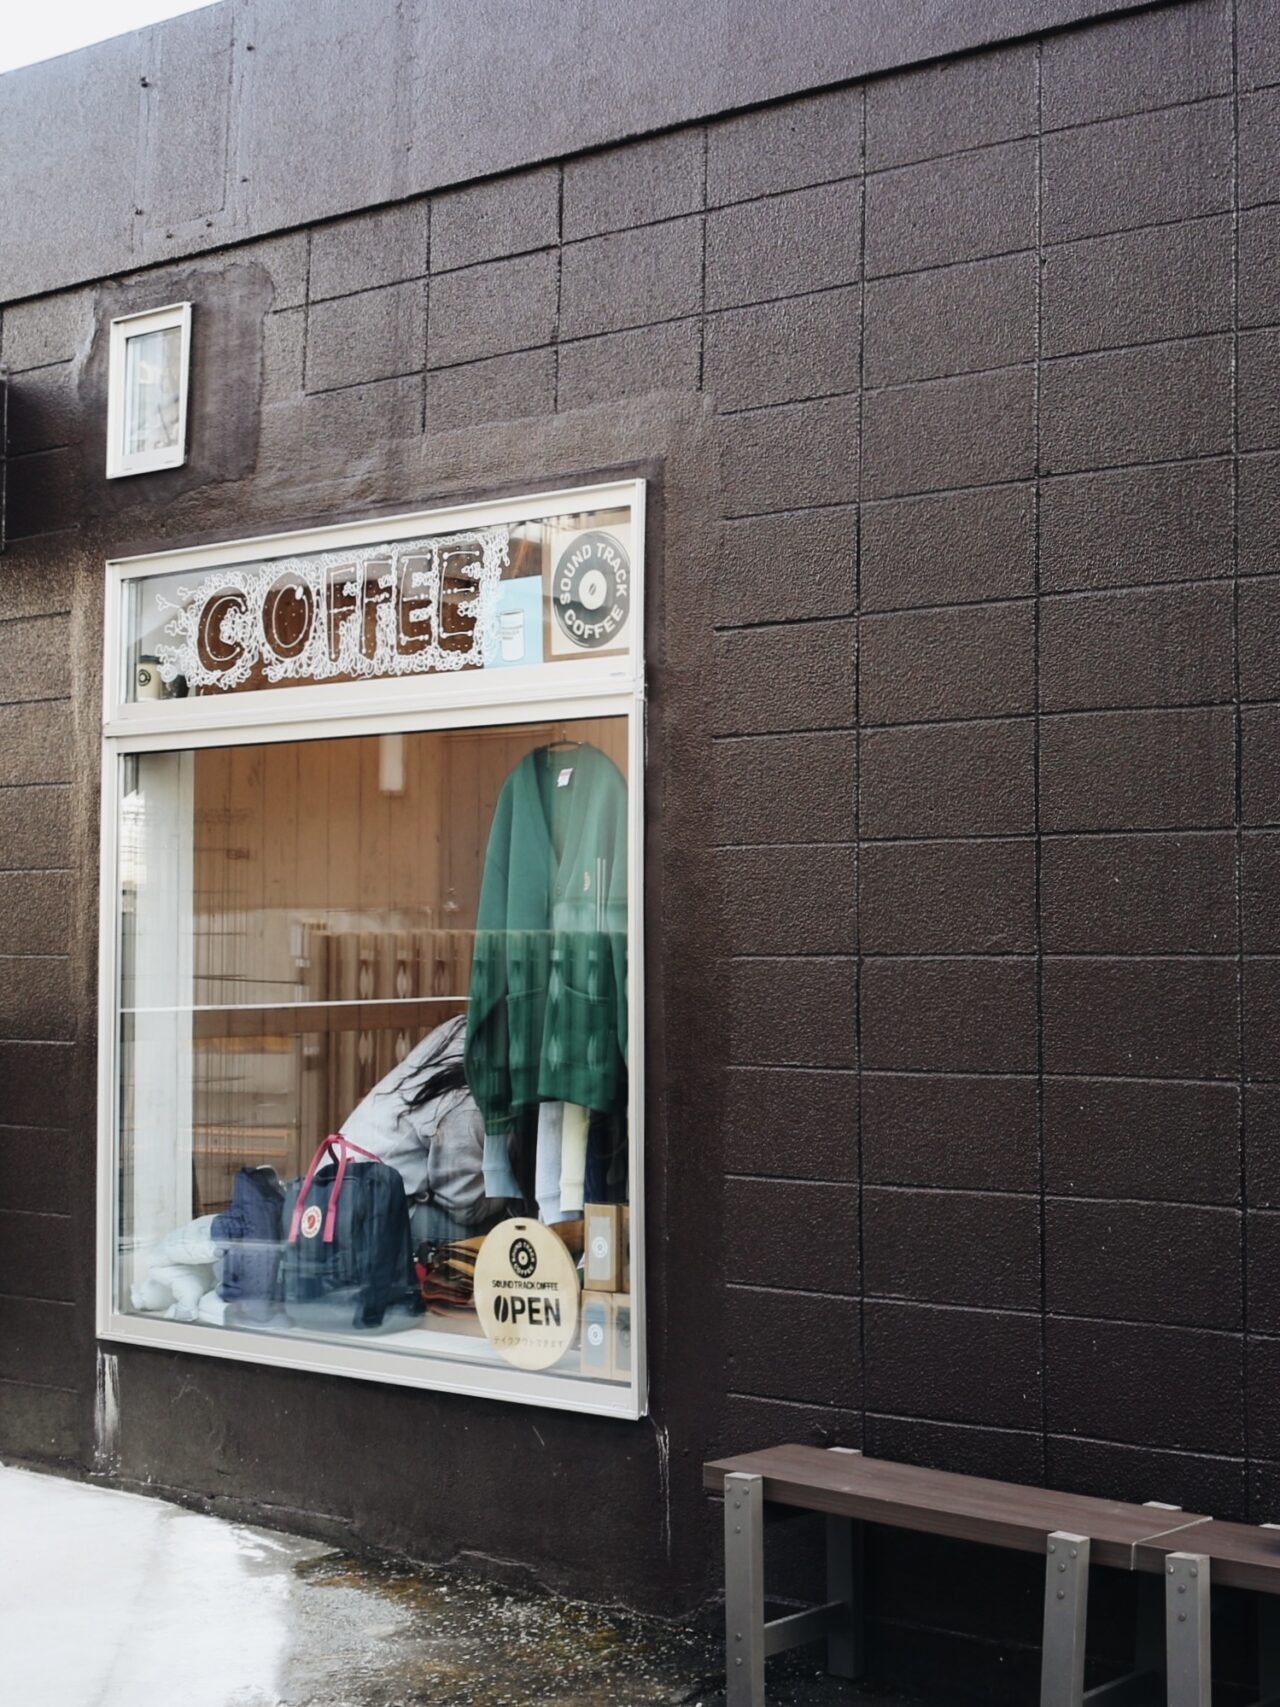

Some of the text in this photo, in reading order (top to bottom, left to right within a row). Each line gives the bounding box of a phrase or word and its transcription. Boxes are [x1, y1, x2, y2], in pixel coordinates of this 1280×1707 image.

[560, 543, 627, 605] SOUND TRACK
[197, 542, 485, 674] COFFEE
[564, 604, 624, 639] COFFEE
[494, 1295, 562, 1327] OPEN
